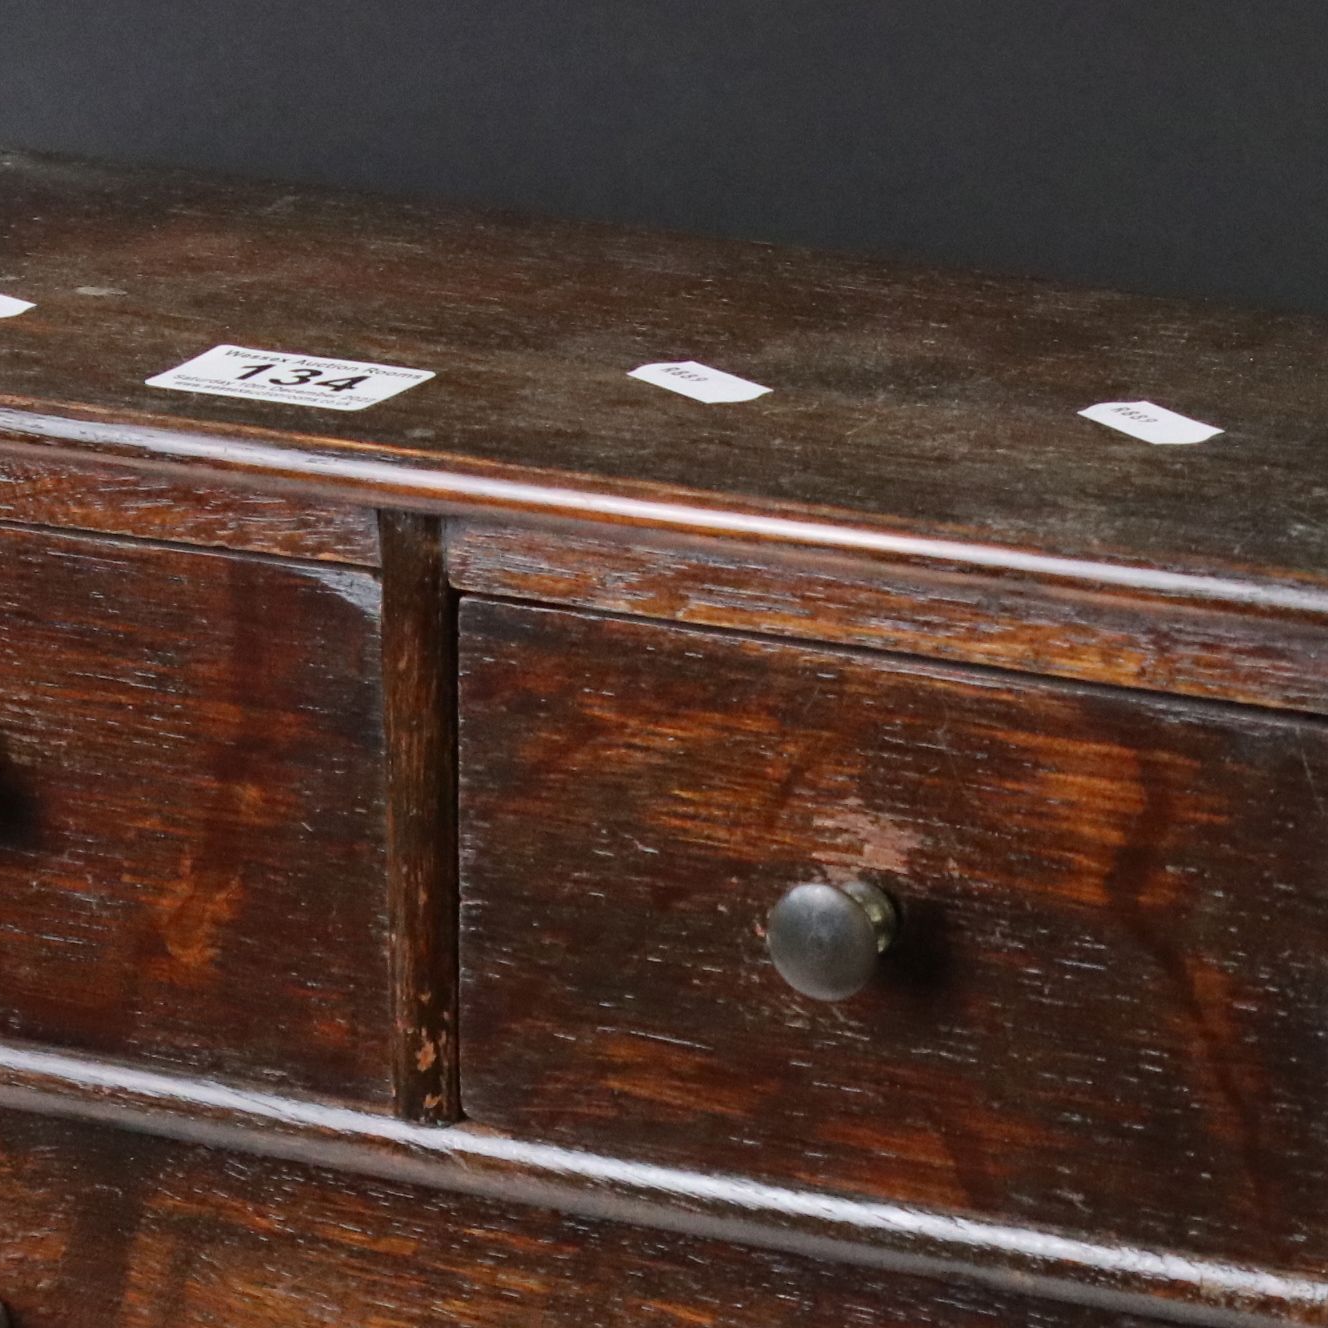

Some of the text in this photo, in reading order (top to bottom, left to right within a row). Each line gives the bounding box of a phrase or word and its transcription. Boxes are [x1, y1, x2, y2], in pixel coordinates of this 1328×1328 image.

[225, 350, 423, 379] Wessex Auction Rooms
[235, 363, 372, 392] 134
[172, 374, 231, 386] Saturday
[270, 386, 336, 398] December
